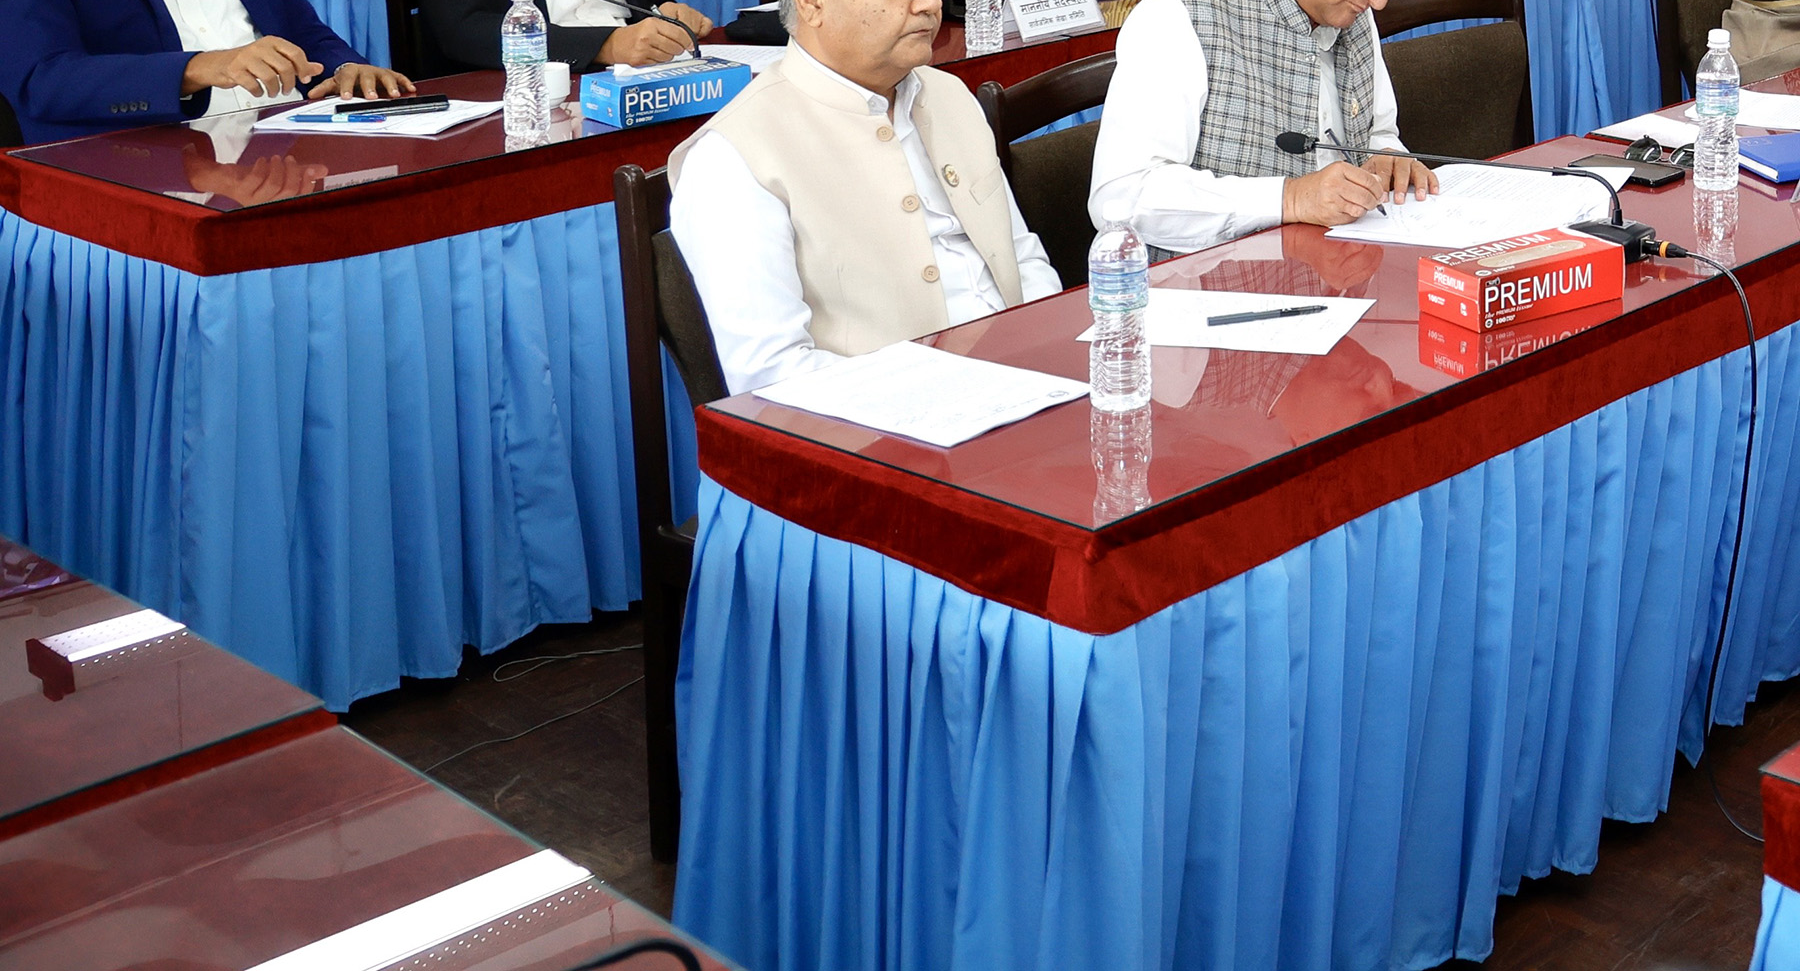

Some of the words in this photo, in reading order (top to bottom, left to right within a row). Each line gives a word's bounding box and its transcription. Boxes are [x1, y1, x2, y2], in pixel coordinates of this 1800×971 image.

[625, 78, 723, 114] PREMIUM
[1434, 233, 1551, 265] PREMIUM
[1433, 271, 1465, 292] PREMIUM
[1484, 263, 1593, 313] PREMIUM
[1495, 306, 1517, 317] PREMIUM
